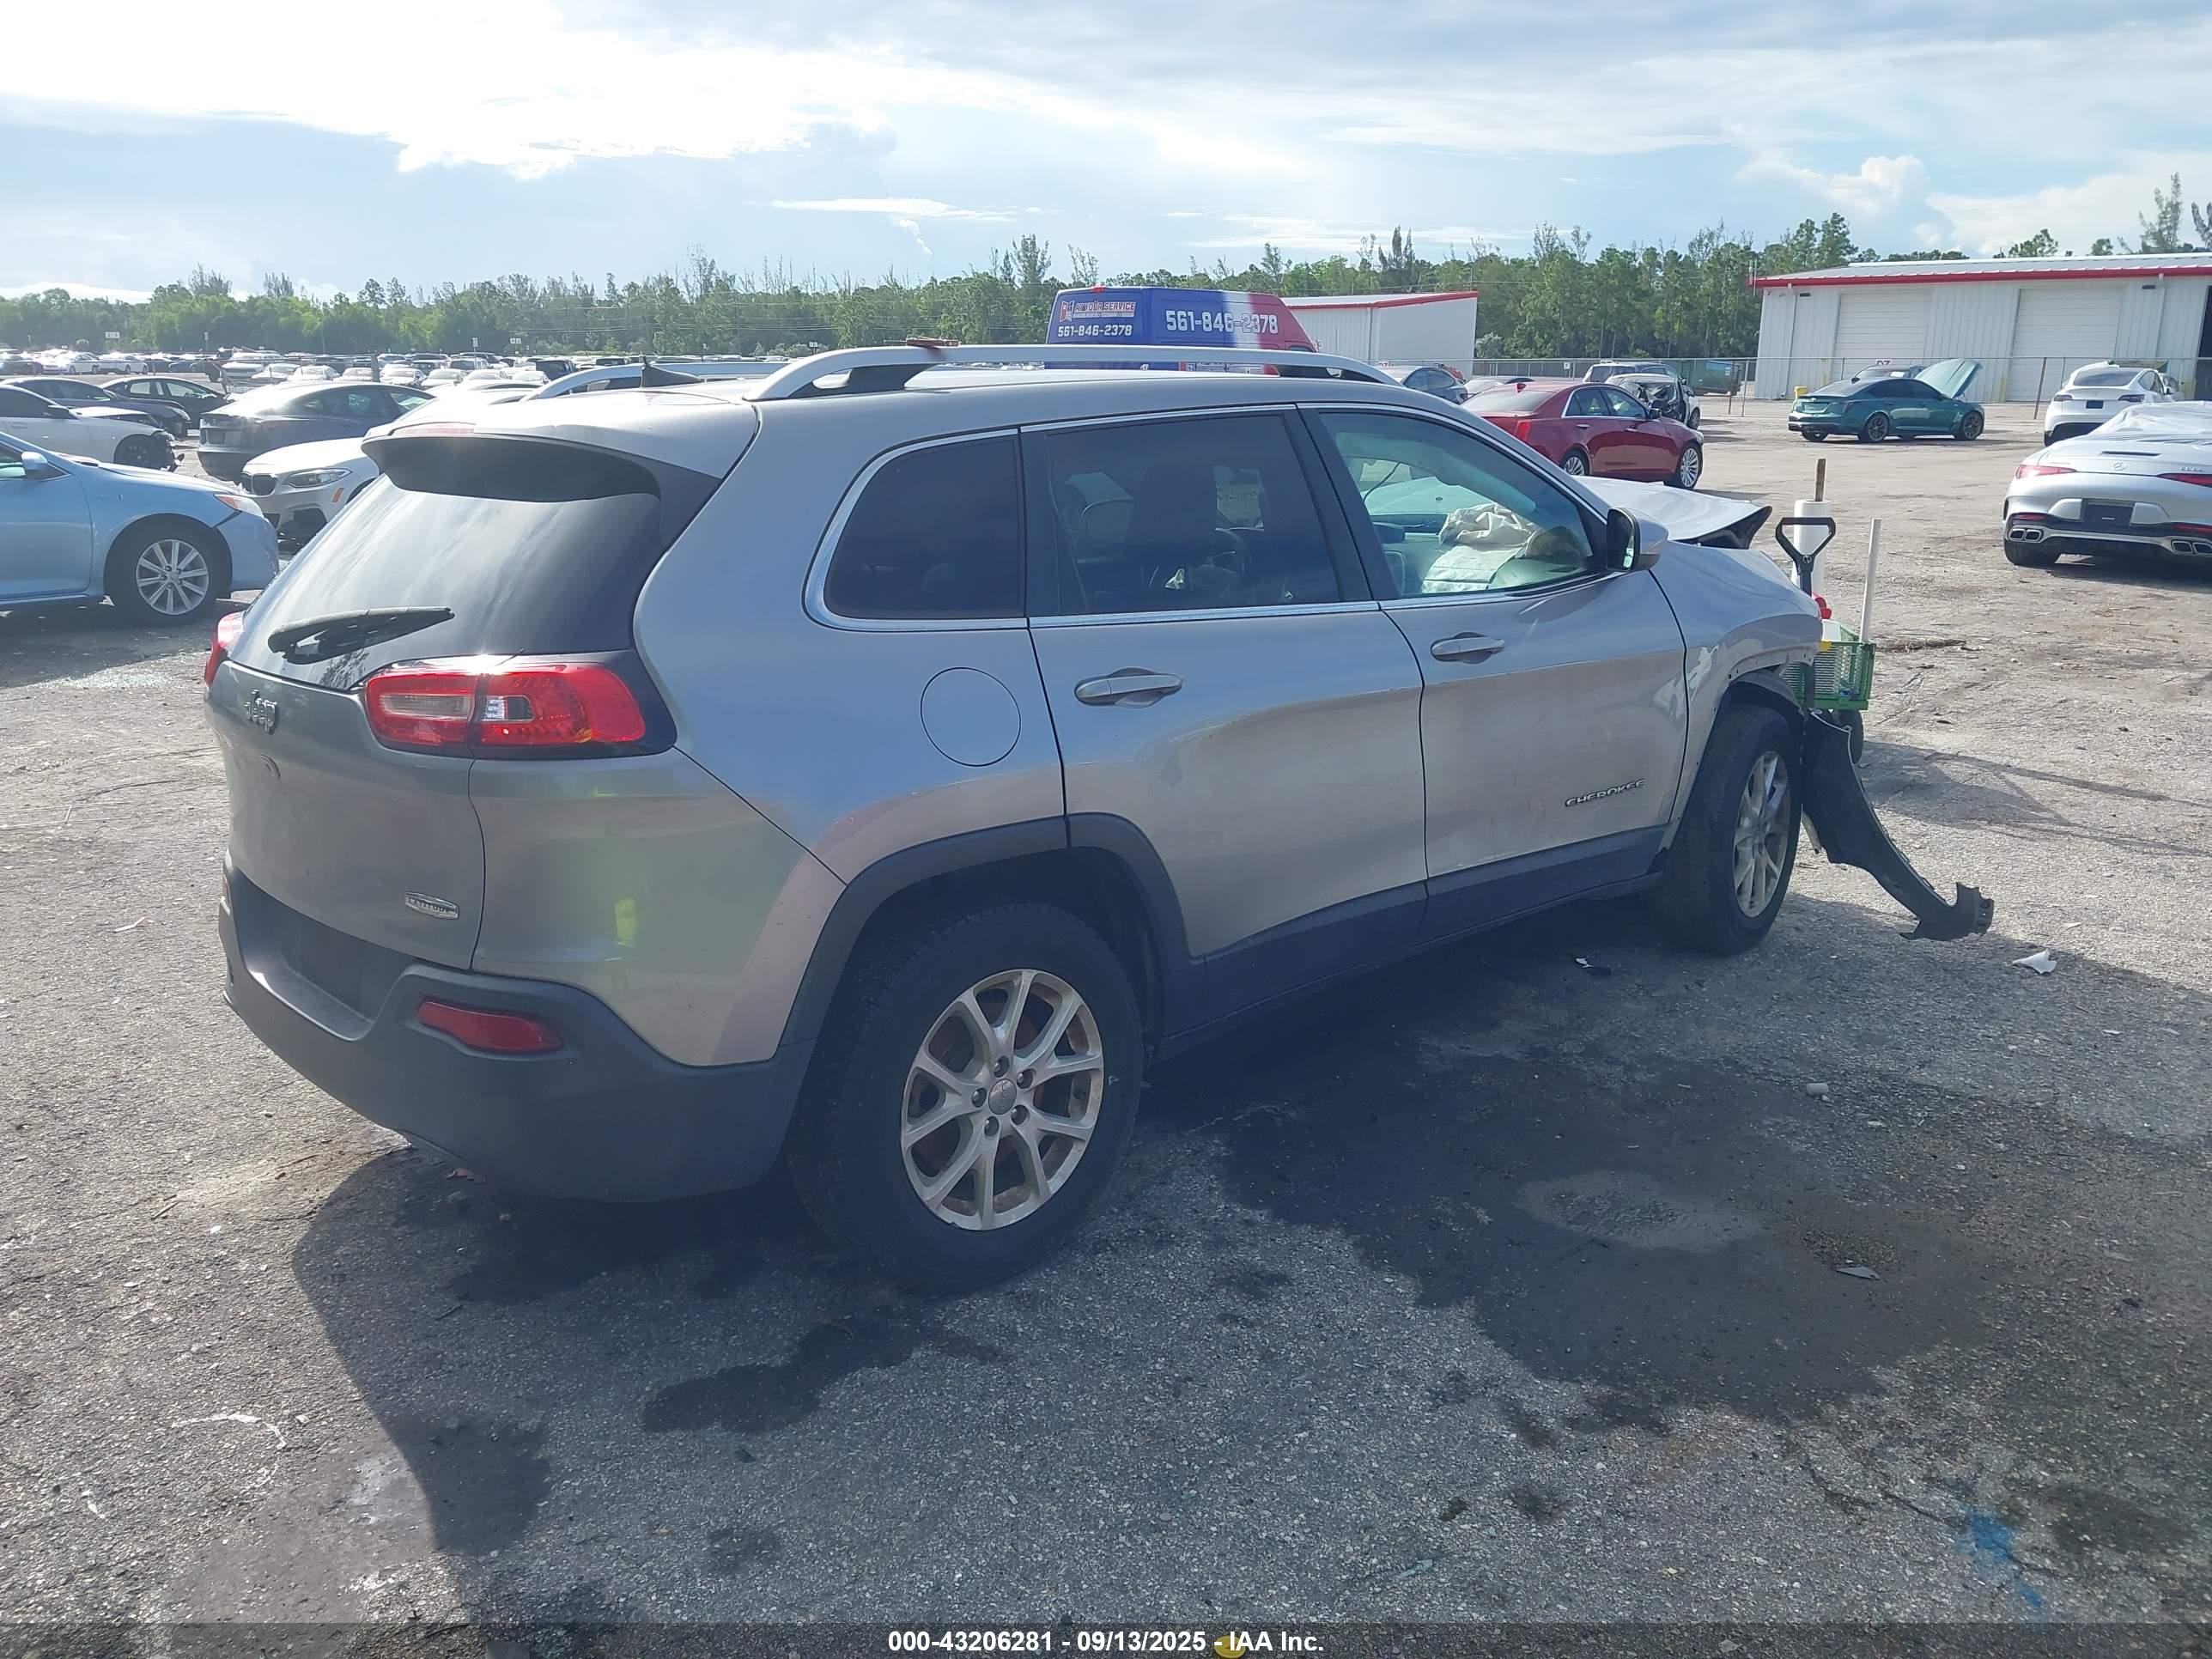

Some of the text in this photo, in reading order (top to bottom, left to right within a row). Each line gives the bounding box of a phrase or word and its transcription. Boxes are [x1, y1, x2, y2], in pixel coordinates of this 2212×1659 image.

[1103, 302, 1136, 311] SERVICE
[1058, 325, 1132, 337] 561-846-2378
[1165, 310, 1279, 334] 561-846-2378
[243, 689, 277, 732] Jeep
[1565, 778, 1647, 807] CHEROKEE
